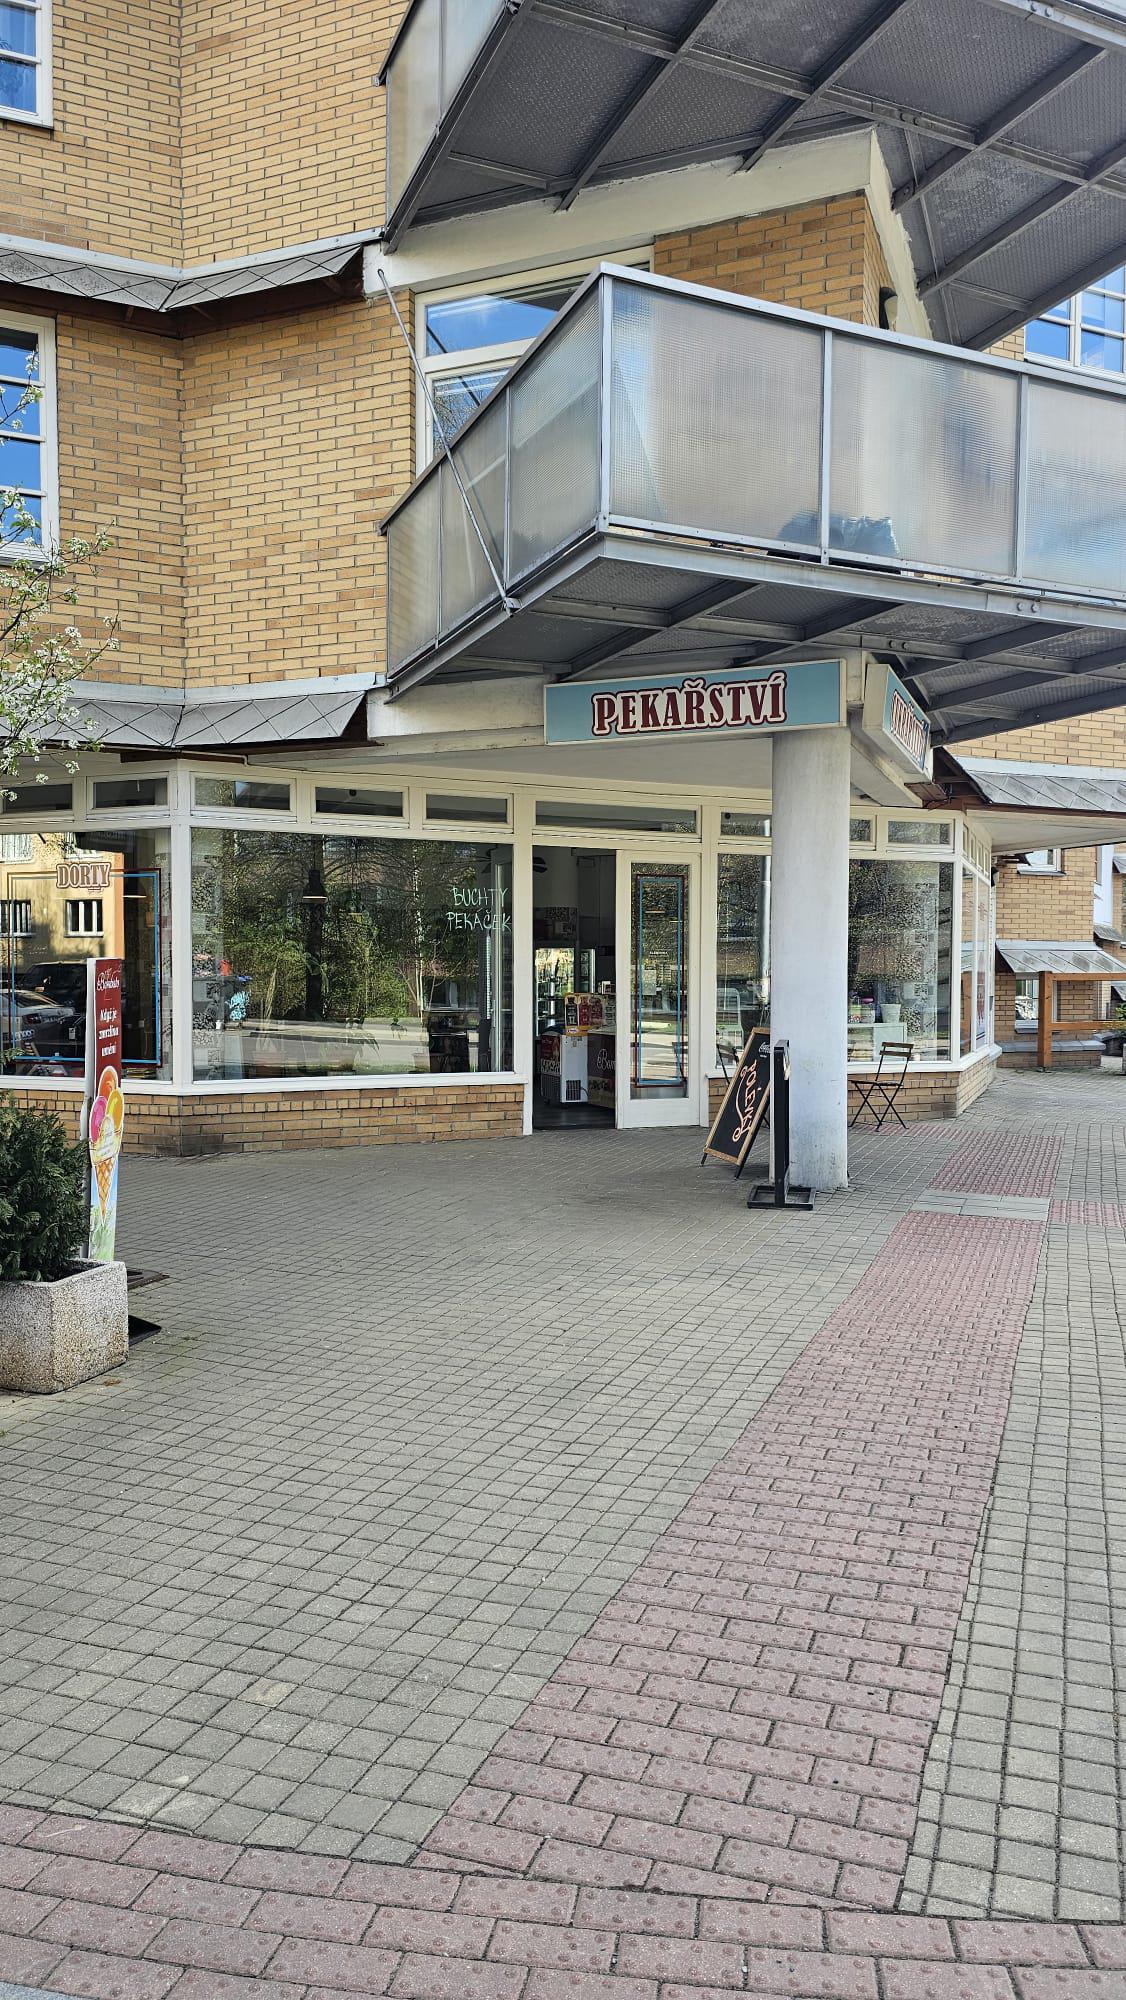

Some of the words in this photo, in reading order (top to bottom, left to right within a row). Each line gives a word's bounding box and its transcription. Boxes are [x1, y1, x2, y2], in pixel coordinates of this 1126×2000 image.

[593, 671, 787, 735] PEKAŘSTVÍ
[57, 863, 110, 887] DORTY
[451, 887, 509, 908] BUCHTY
[446, 908, 512, 932] PEKÁČEK
